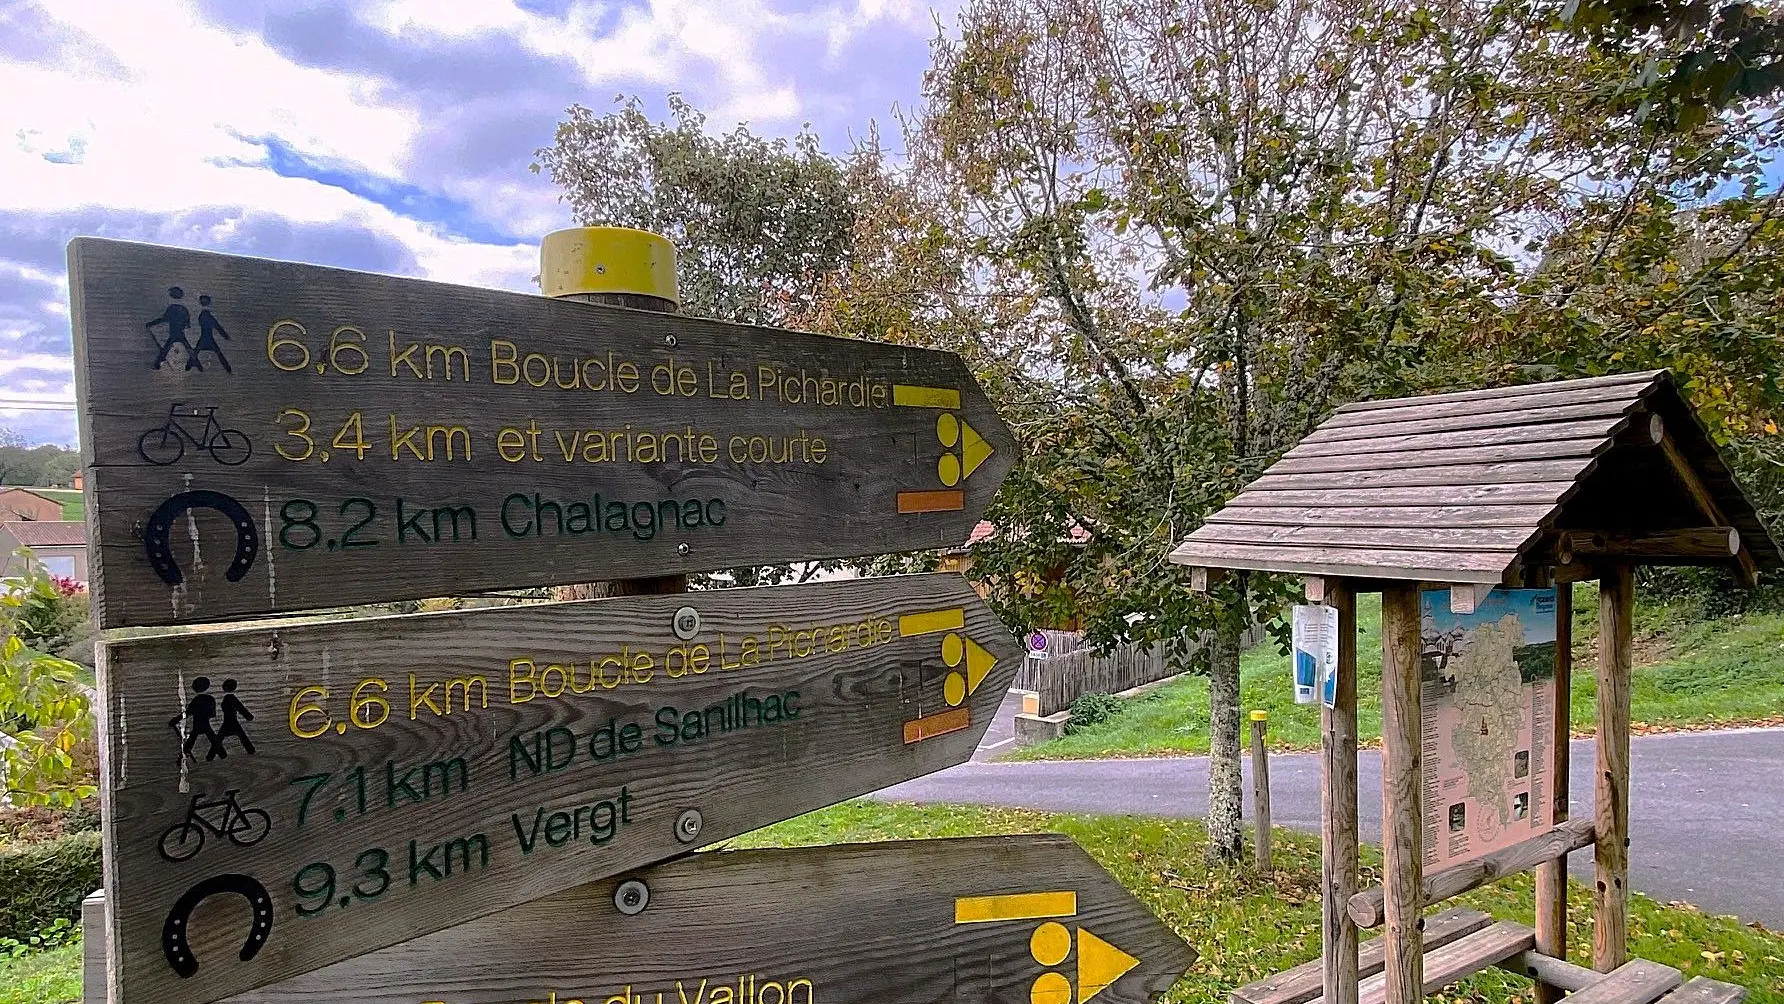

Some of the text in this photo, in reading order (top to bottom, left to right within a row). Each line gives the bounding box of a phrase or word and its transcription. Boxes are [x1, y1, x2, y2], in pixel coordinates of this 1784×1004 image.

[388, 330, 472, 382] km
[491, 341, 639, 394] Boucle
[652, 358, 698, 398] de
[709, 361, 748, 400] La
[758, 367, 889, 410] Pichardie
[391, 414, 473, 462] km
[497, 418, 544, 464] et
[555, 424, 718, 463] variante
[728, 431, 827, 464] courte
[397, 499, 478, 545] km
[501, 493, 728, 542] Chalagnac
[409, 673, 489, 721] km
[508, 645, 656, 704] Boucle
[664, 640, 711, 678] de
[720, 633, 760, 670] La
[769, 616, 893, 660] Pichardie
[387, 755, 470, 804] km
[507, 728, 577, 781] ND
[589, 718, 644, 763] de
[655, 690, 802, 748] Sanilhac
[408, 831, 491, 887] km
[511, 786, 633, 855] Vergt
